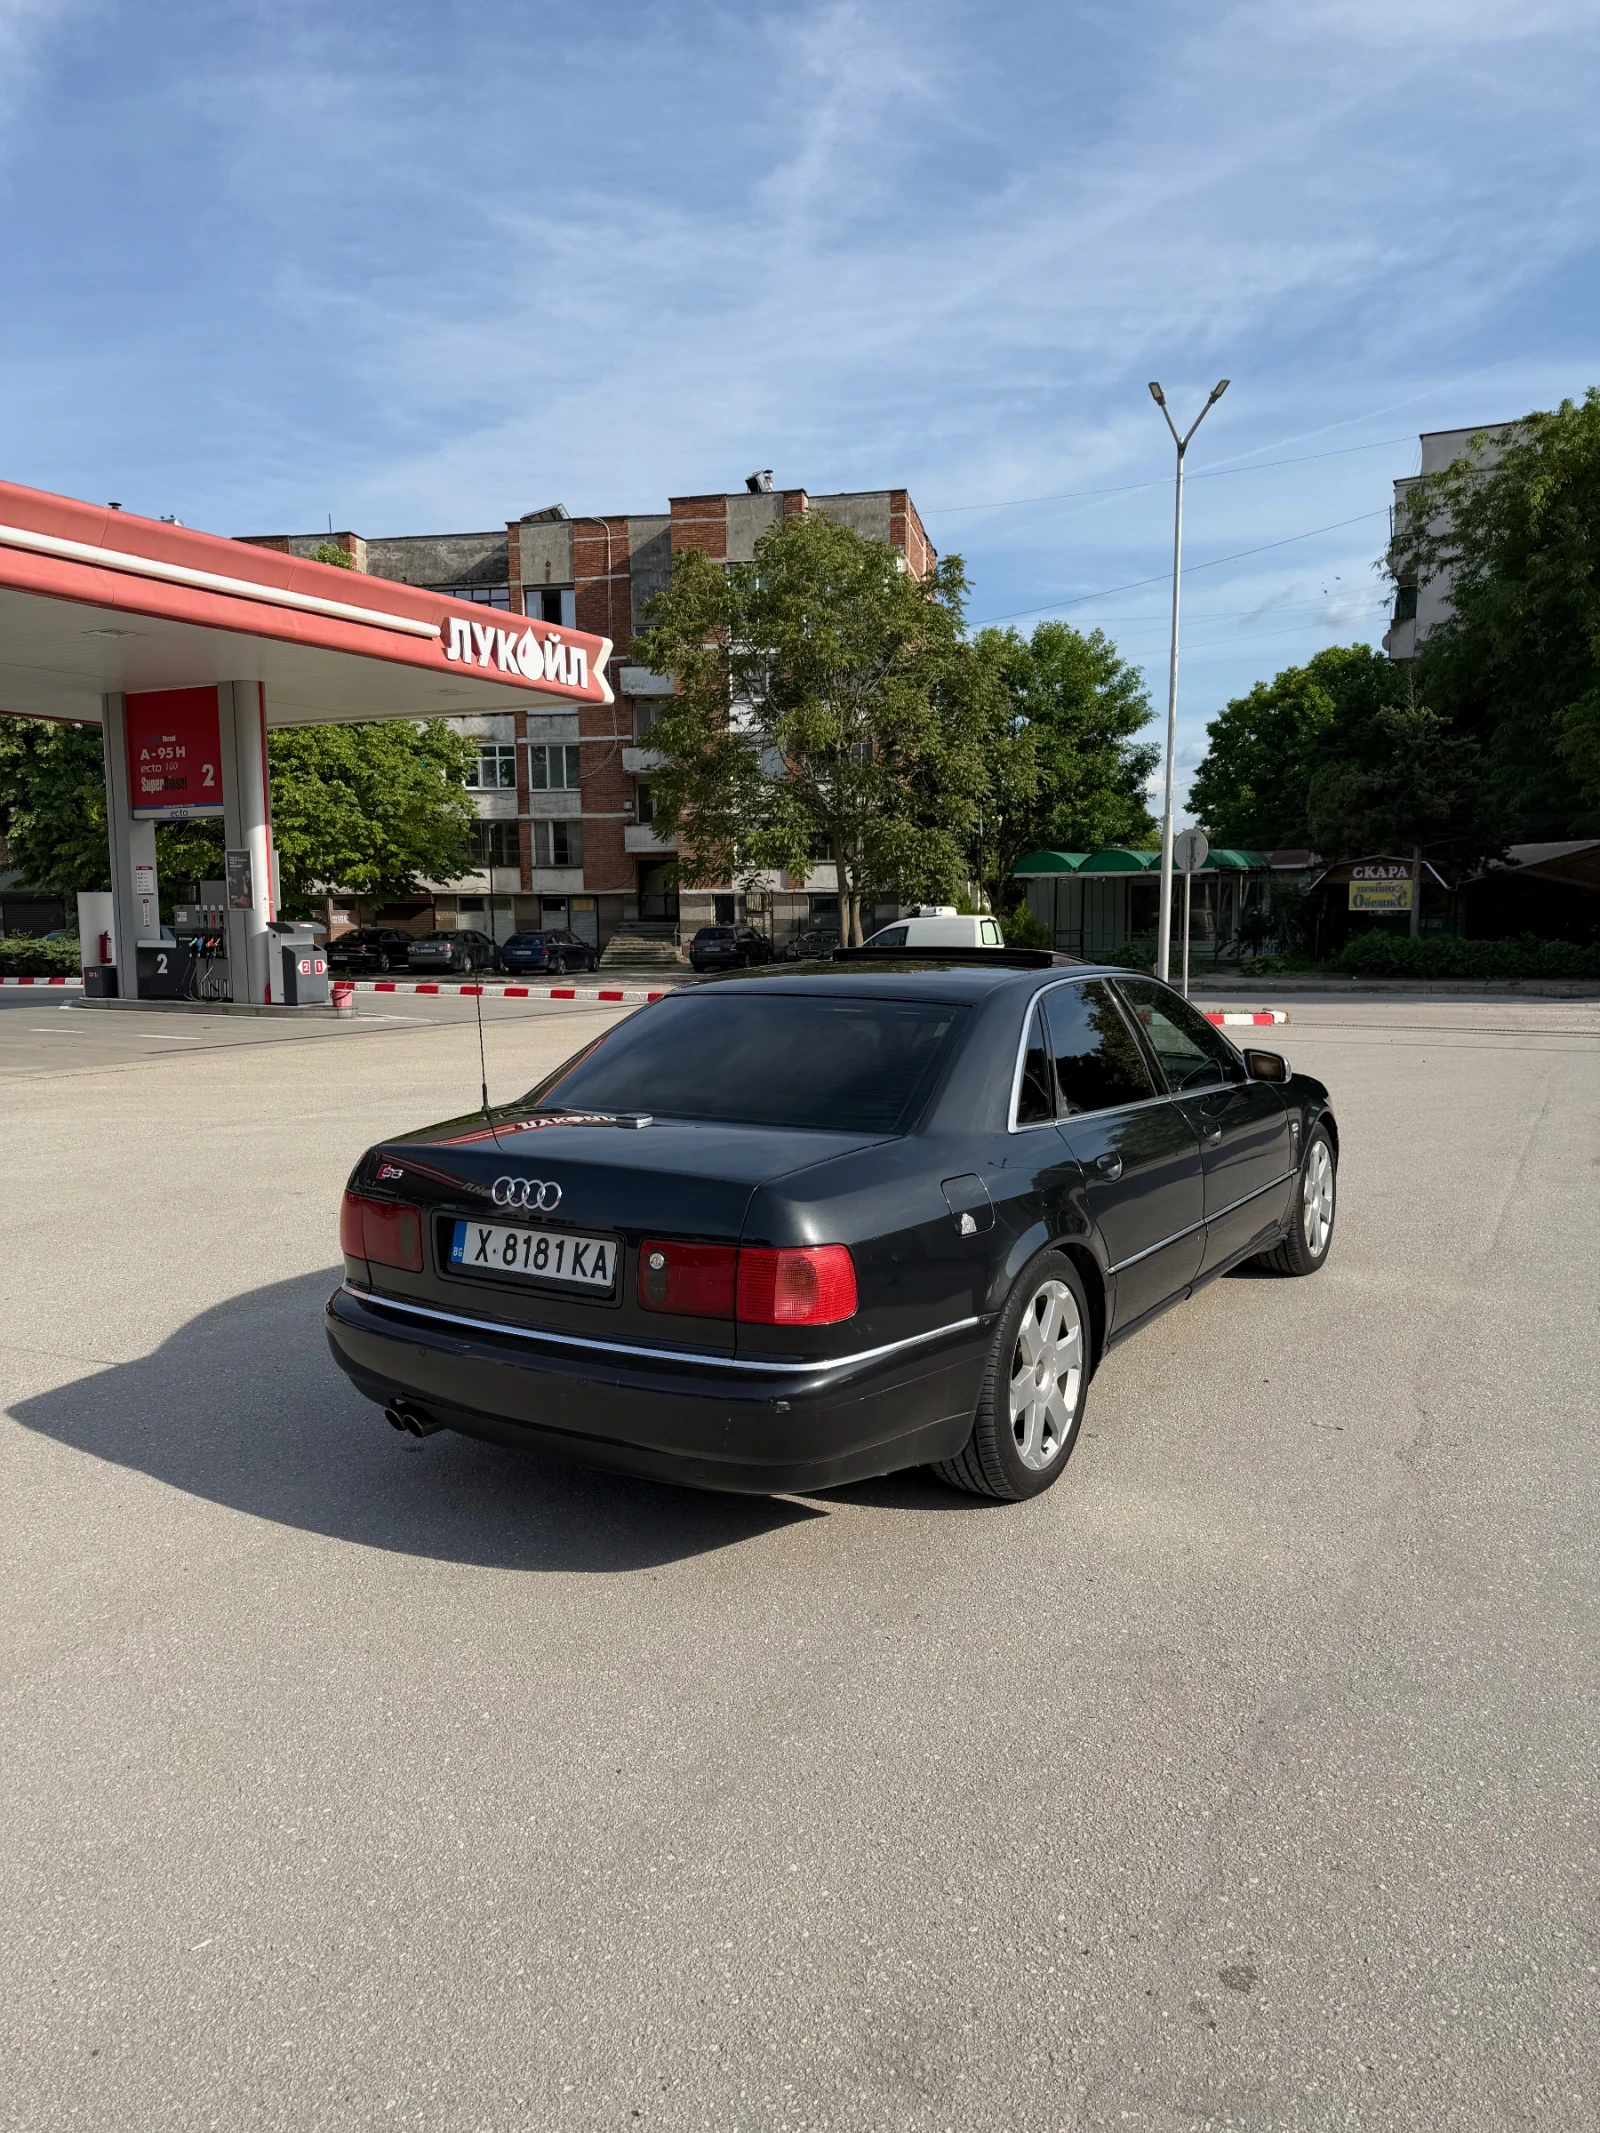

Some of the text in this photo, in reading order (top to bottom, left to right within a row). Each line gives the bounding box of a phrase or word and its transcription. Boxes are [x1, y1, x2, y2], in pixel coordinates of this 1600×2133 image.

[446, 617, 588, 689] ЛУКОЙЛ
[141, 762, 179, 773] ecto 100
[201, 763, 215, 787] 2
[170, 809, 189, 817] ecto
[1352, 865, 1409, 879] СКАРА
[156, 953, 168, 974] 2
[302, 962, 322, 972] 2 1
[382, 1165, 404, 1179] S8
[453, 1246, 464, 1257] BG
